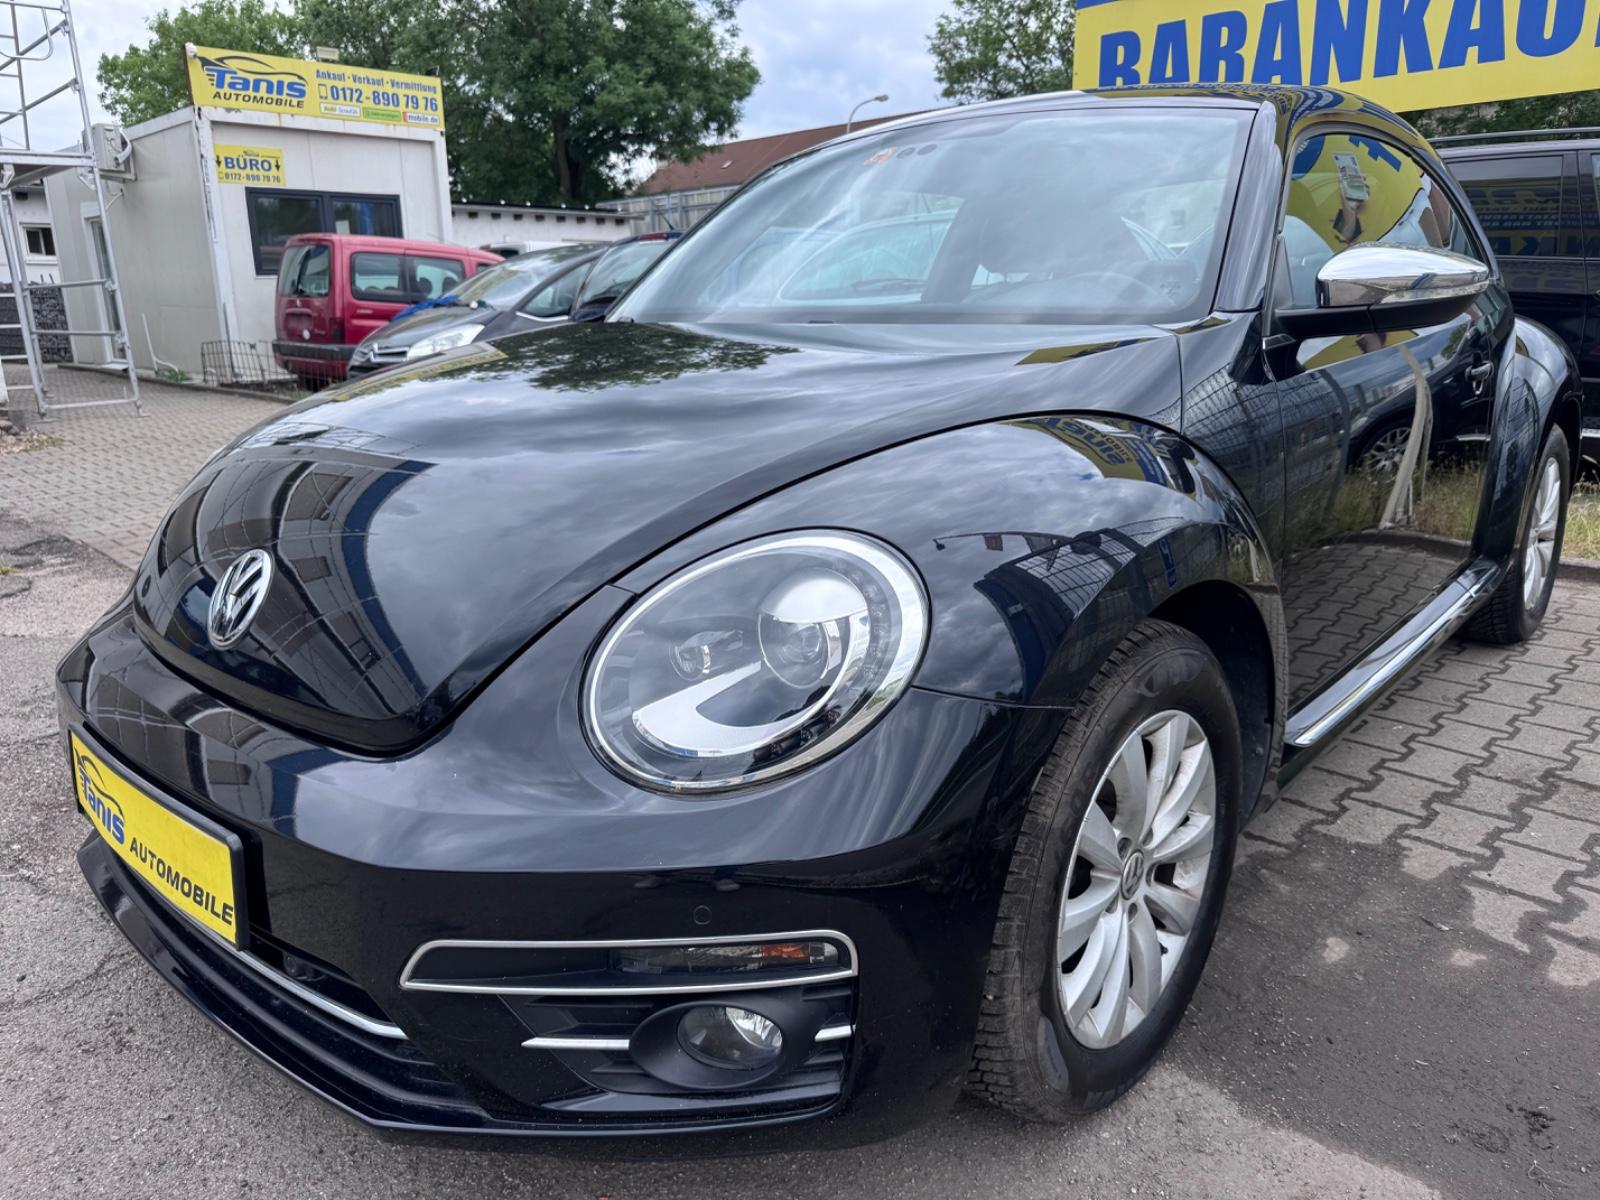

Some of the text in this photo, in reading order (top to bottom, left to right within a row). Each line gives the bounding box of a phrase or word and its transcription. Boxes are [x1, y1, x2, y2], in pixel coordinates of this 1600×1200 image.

[1099, 0, 1600, 87] BARANKAU
[352, 74, 384, 87] Verkauf
[390, 79, 437, 94] Vermittlung
[213, 91, 304, 109] AUTOMOBILE
[403, 94, 420, 110] 79
[422, 96, 438, 112] 76
[224, 154, 272, 172] BÜRO
[130, 837, 234, 926] AUTOMOBILE
